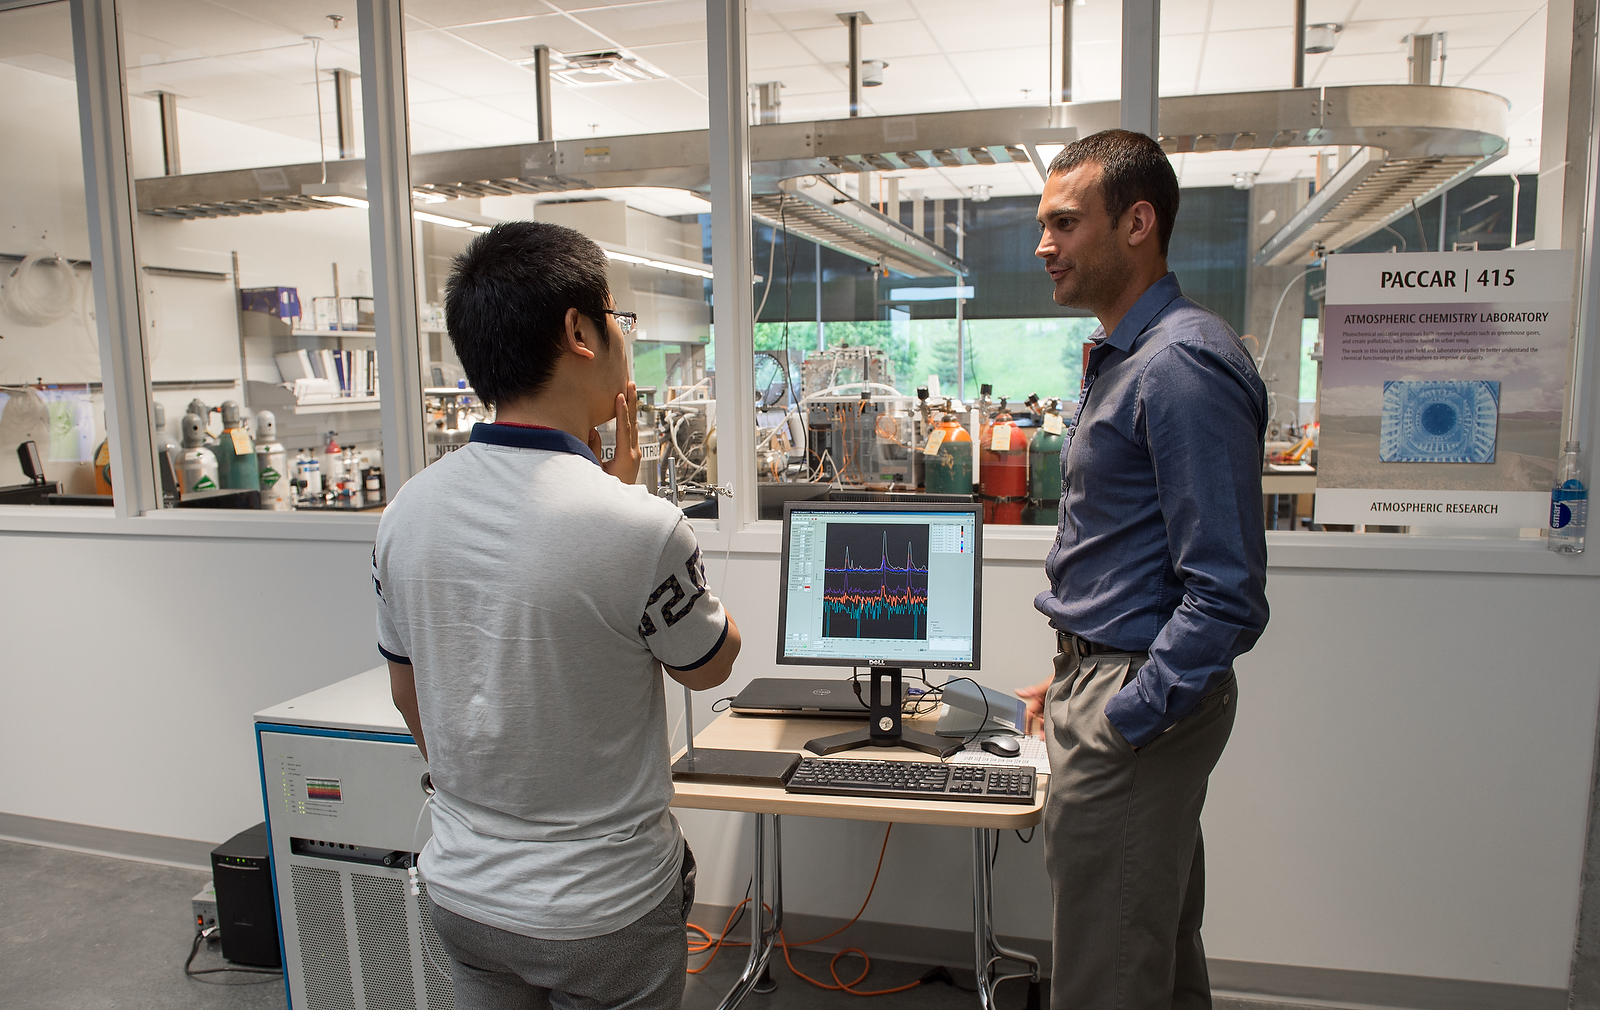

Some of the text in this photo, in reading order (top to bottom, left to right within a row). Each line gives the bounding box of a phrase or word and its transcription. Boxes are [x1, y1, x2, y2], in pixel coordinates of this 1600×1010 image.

[1380, 270, 1456, 288] PACCAR
[1477, 269, 1515, 287] 415
[1344, 311, 1549, 325] ATMOSPHERIC CHEMISTRY LABORATORY
[1370, 502, 1498, 514] ATMOSPHERIC RESEARCH
